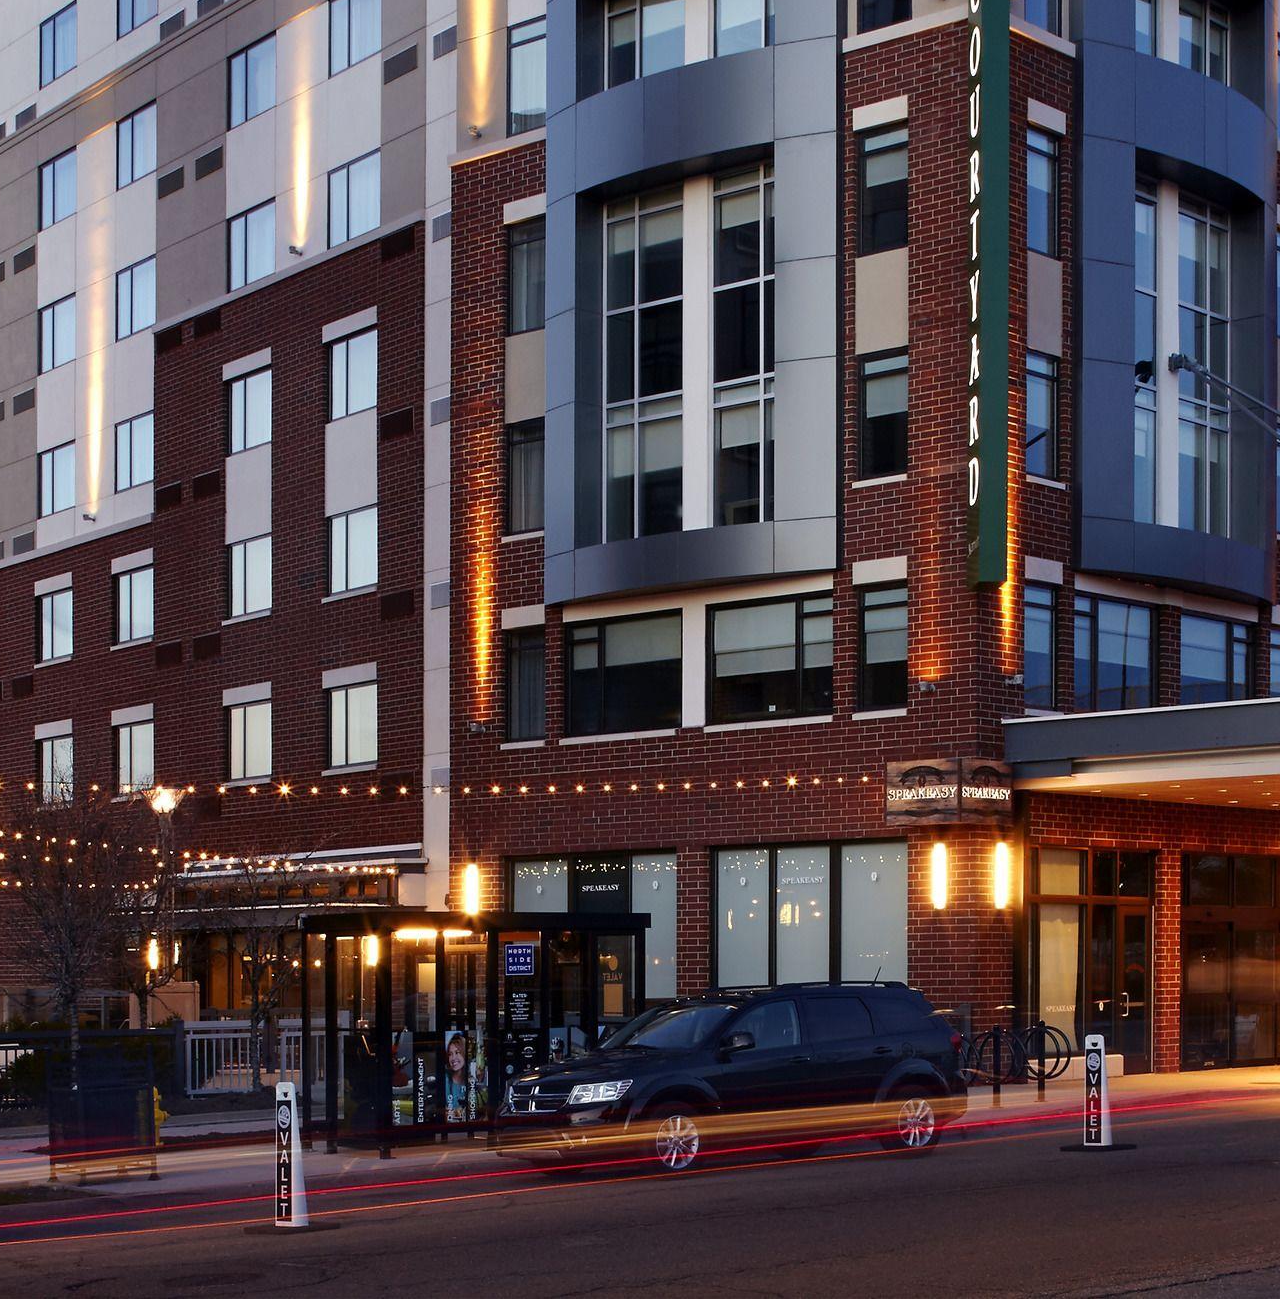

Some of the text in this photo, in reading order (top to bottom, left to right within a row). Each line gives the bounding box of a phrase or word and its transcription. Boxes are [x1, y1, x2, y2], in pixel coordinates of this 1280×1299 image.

[887, 786, 958, 801] SPEAKEASY
[962, 786, 1011, 800] SPEAKEASY
[581, 884, 620, 893] SPEAKEASY
[781, 876, 825, 885] SPEAKEASY
[417, 1057, 425, 1123] ENTERTAINMENT
[393, 1099, 401, 1124] ARTS
[1089, 1073, 1099, 1140] VALET
[279, 1131, 289, 1217] VALET
